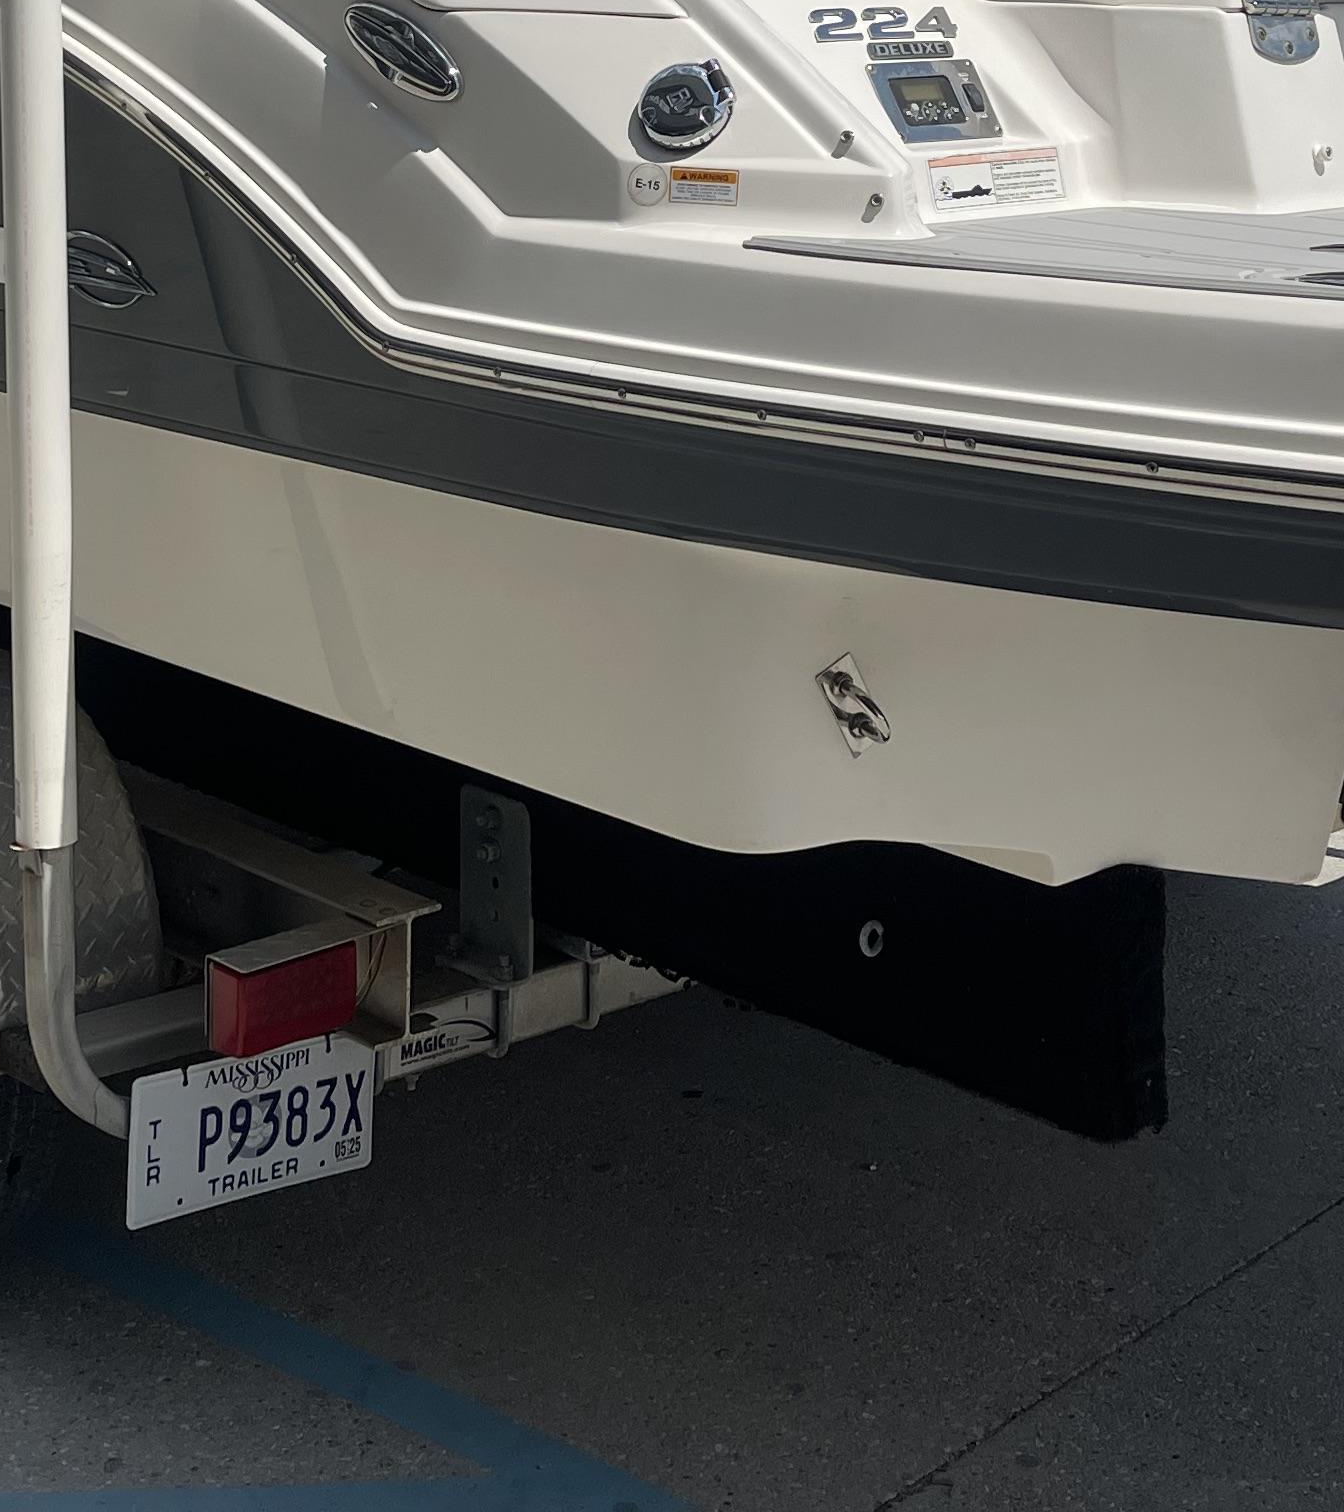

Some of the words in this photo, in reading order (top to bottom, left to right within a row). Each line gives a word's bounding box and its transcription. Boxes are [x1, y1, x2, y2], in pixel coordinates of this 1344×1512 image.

[808, 6, 958, 43] 224
[875, 41, 948, 57] DELUXE
[635, 178, 661, 191] E-15
[400, 1033, 446, 1061] MAGIC
[206, 1048, 310, 1092] MISSISSIPPI
[198, 1070, 366, 1173] P9383X
[208, 1157, 300, 1197] TRAILER
